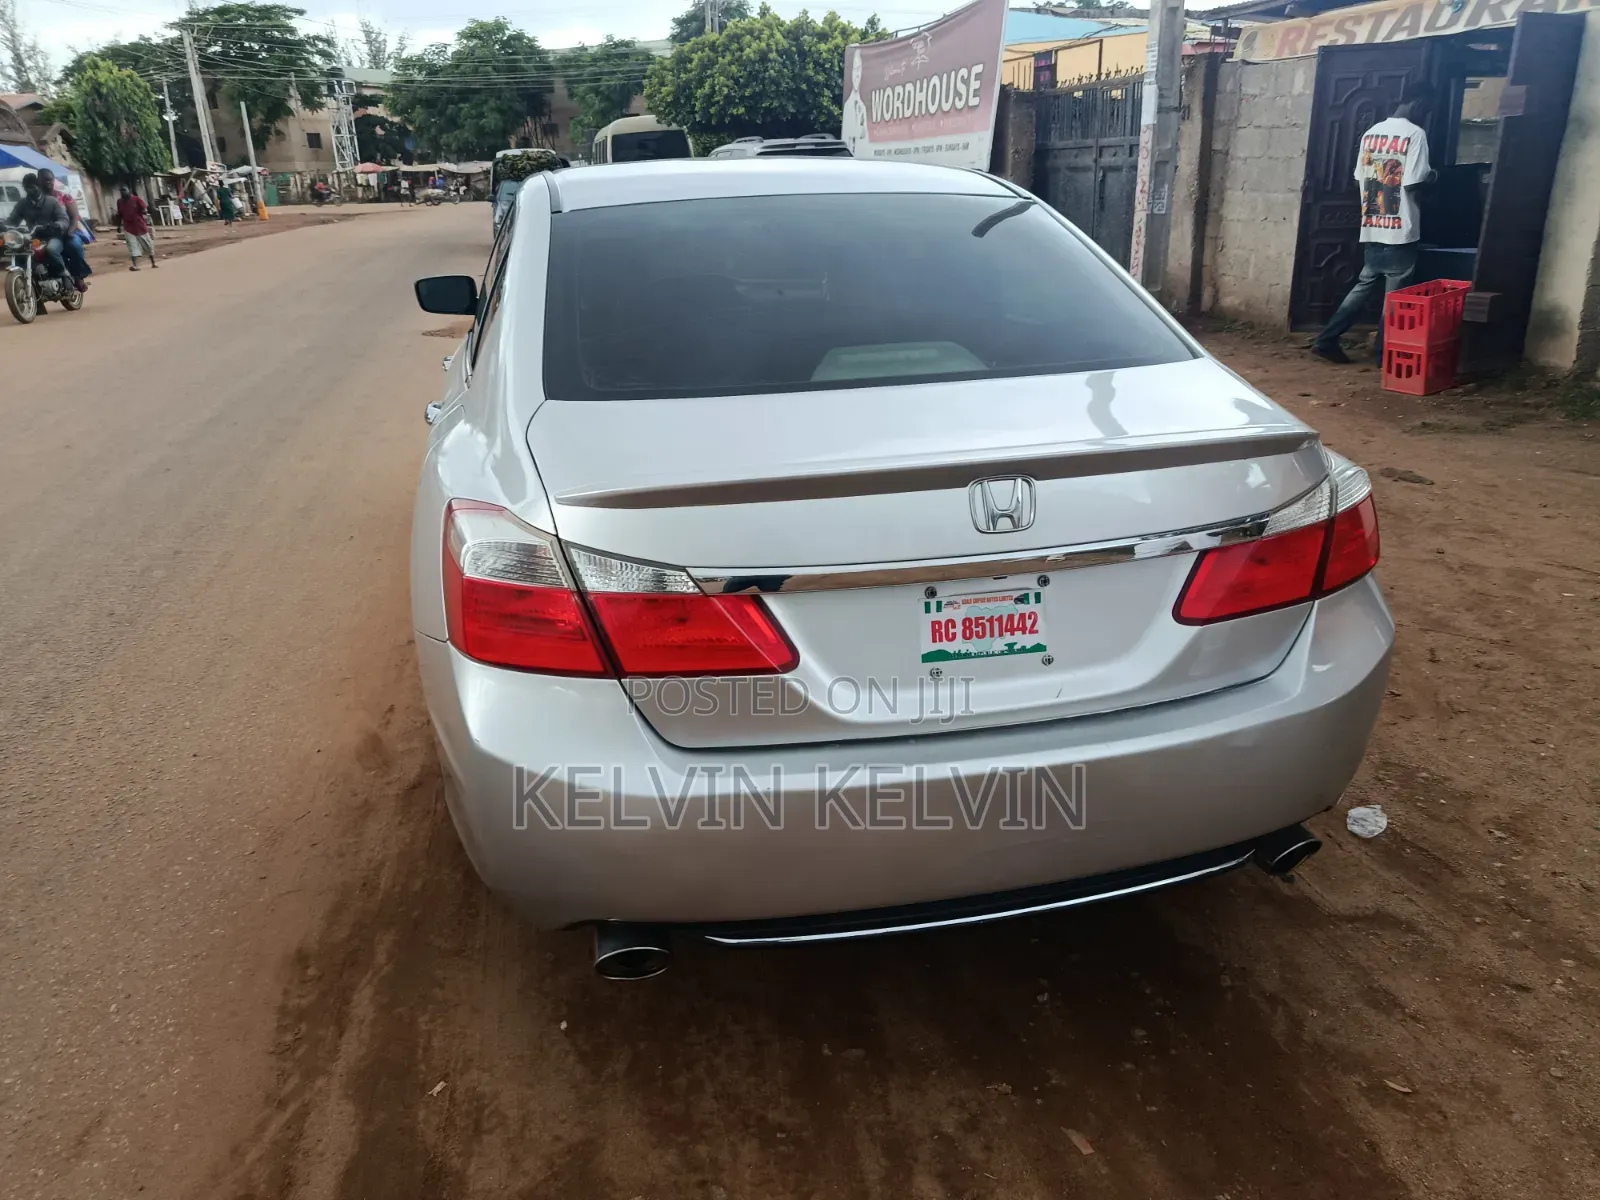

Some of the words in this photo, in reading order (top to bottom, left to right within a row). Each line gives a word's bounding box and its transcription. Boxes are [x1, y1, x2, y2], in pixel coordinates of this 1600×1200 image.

[871, 63, 984, 124] WORDHOUSE
[931, 618, 957, 644] RC
[962, 611, 1038, 640] 8511442
